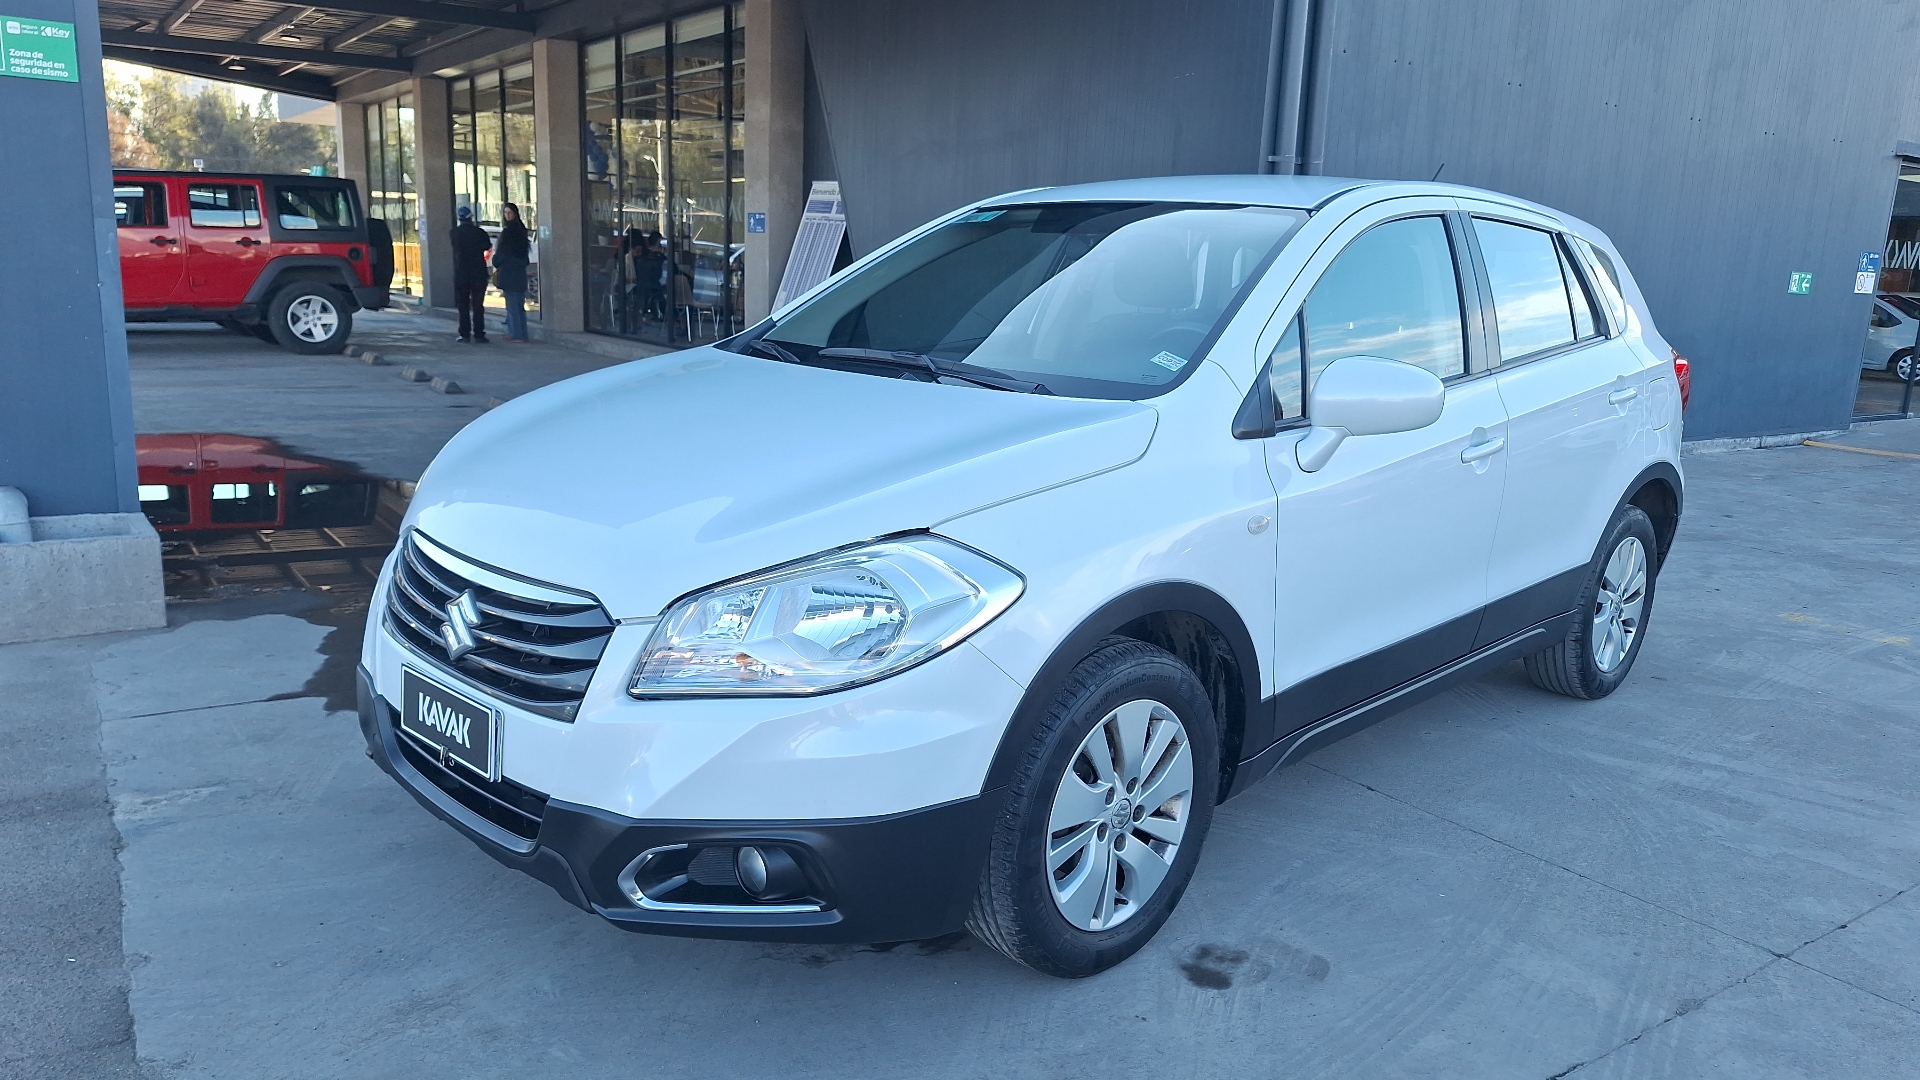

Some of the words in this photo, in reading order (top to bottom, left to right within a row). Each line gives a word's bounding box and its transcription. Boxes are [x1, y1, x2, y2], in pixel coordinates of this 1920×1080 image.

[52, 27, 70, 38] Key
[9, 48, 31, 57] Zona
[32, 51, 43, 59] de
[10, 57, 53, 68] seguridad
[31, 67, 42, 75] de
[43, 68, 69, 77] sismo
[418, 691, 472, 749] KAVAK
